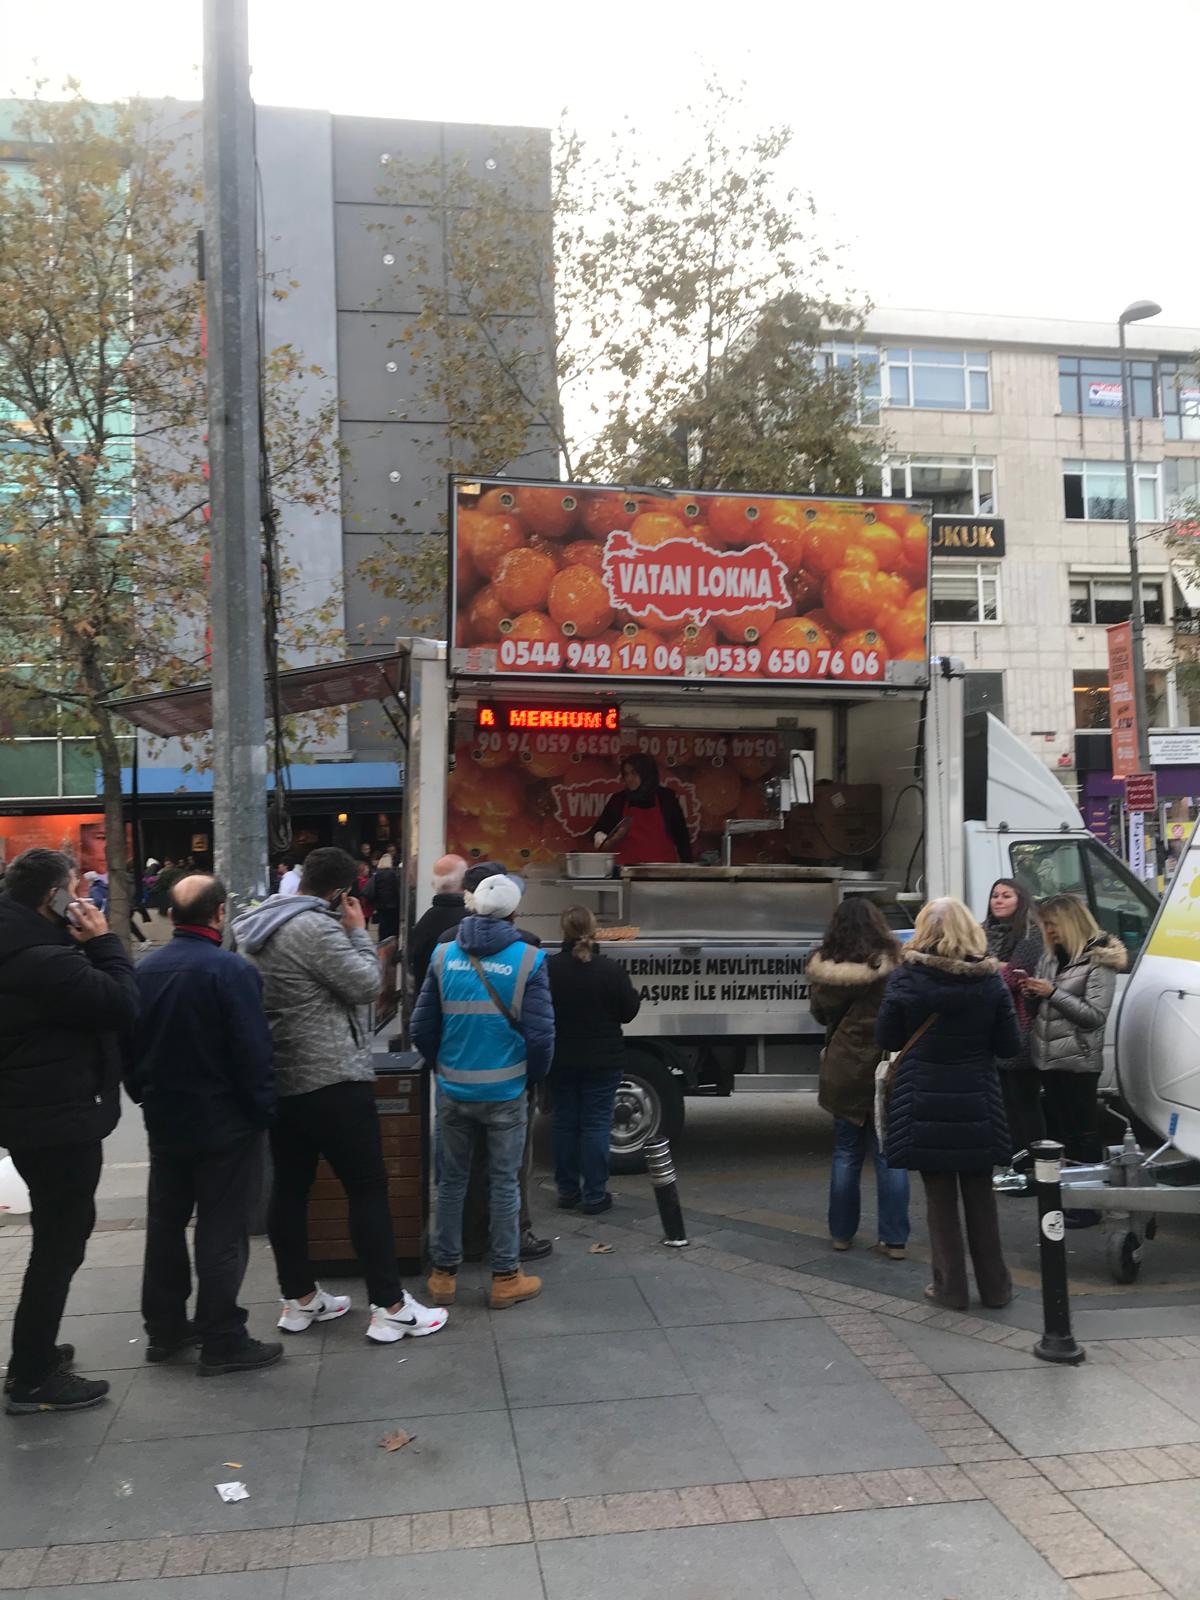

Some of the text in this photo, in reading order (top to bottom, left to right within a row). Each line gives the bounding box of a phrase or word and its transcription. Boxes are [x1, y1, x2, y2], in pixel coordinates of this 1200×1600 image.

[619, 563, 773, 599] VATAN LOKMA
[501, 640, 879, 675] 0544 942 14 06 0539 650 76 06
[509, 710, 602, 728] MERHUM
[478, 731, 776, 757] 0544 942 14 06 0539 650 76 06
[639, 984, 689, 1006] AŞURE
[694, 979, 716, 1001] İLE
